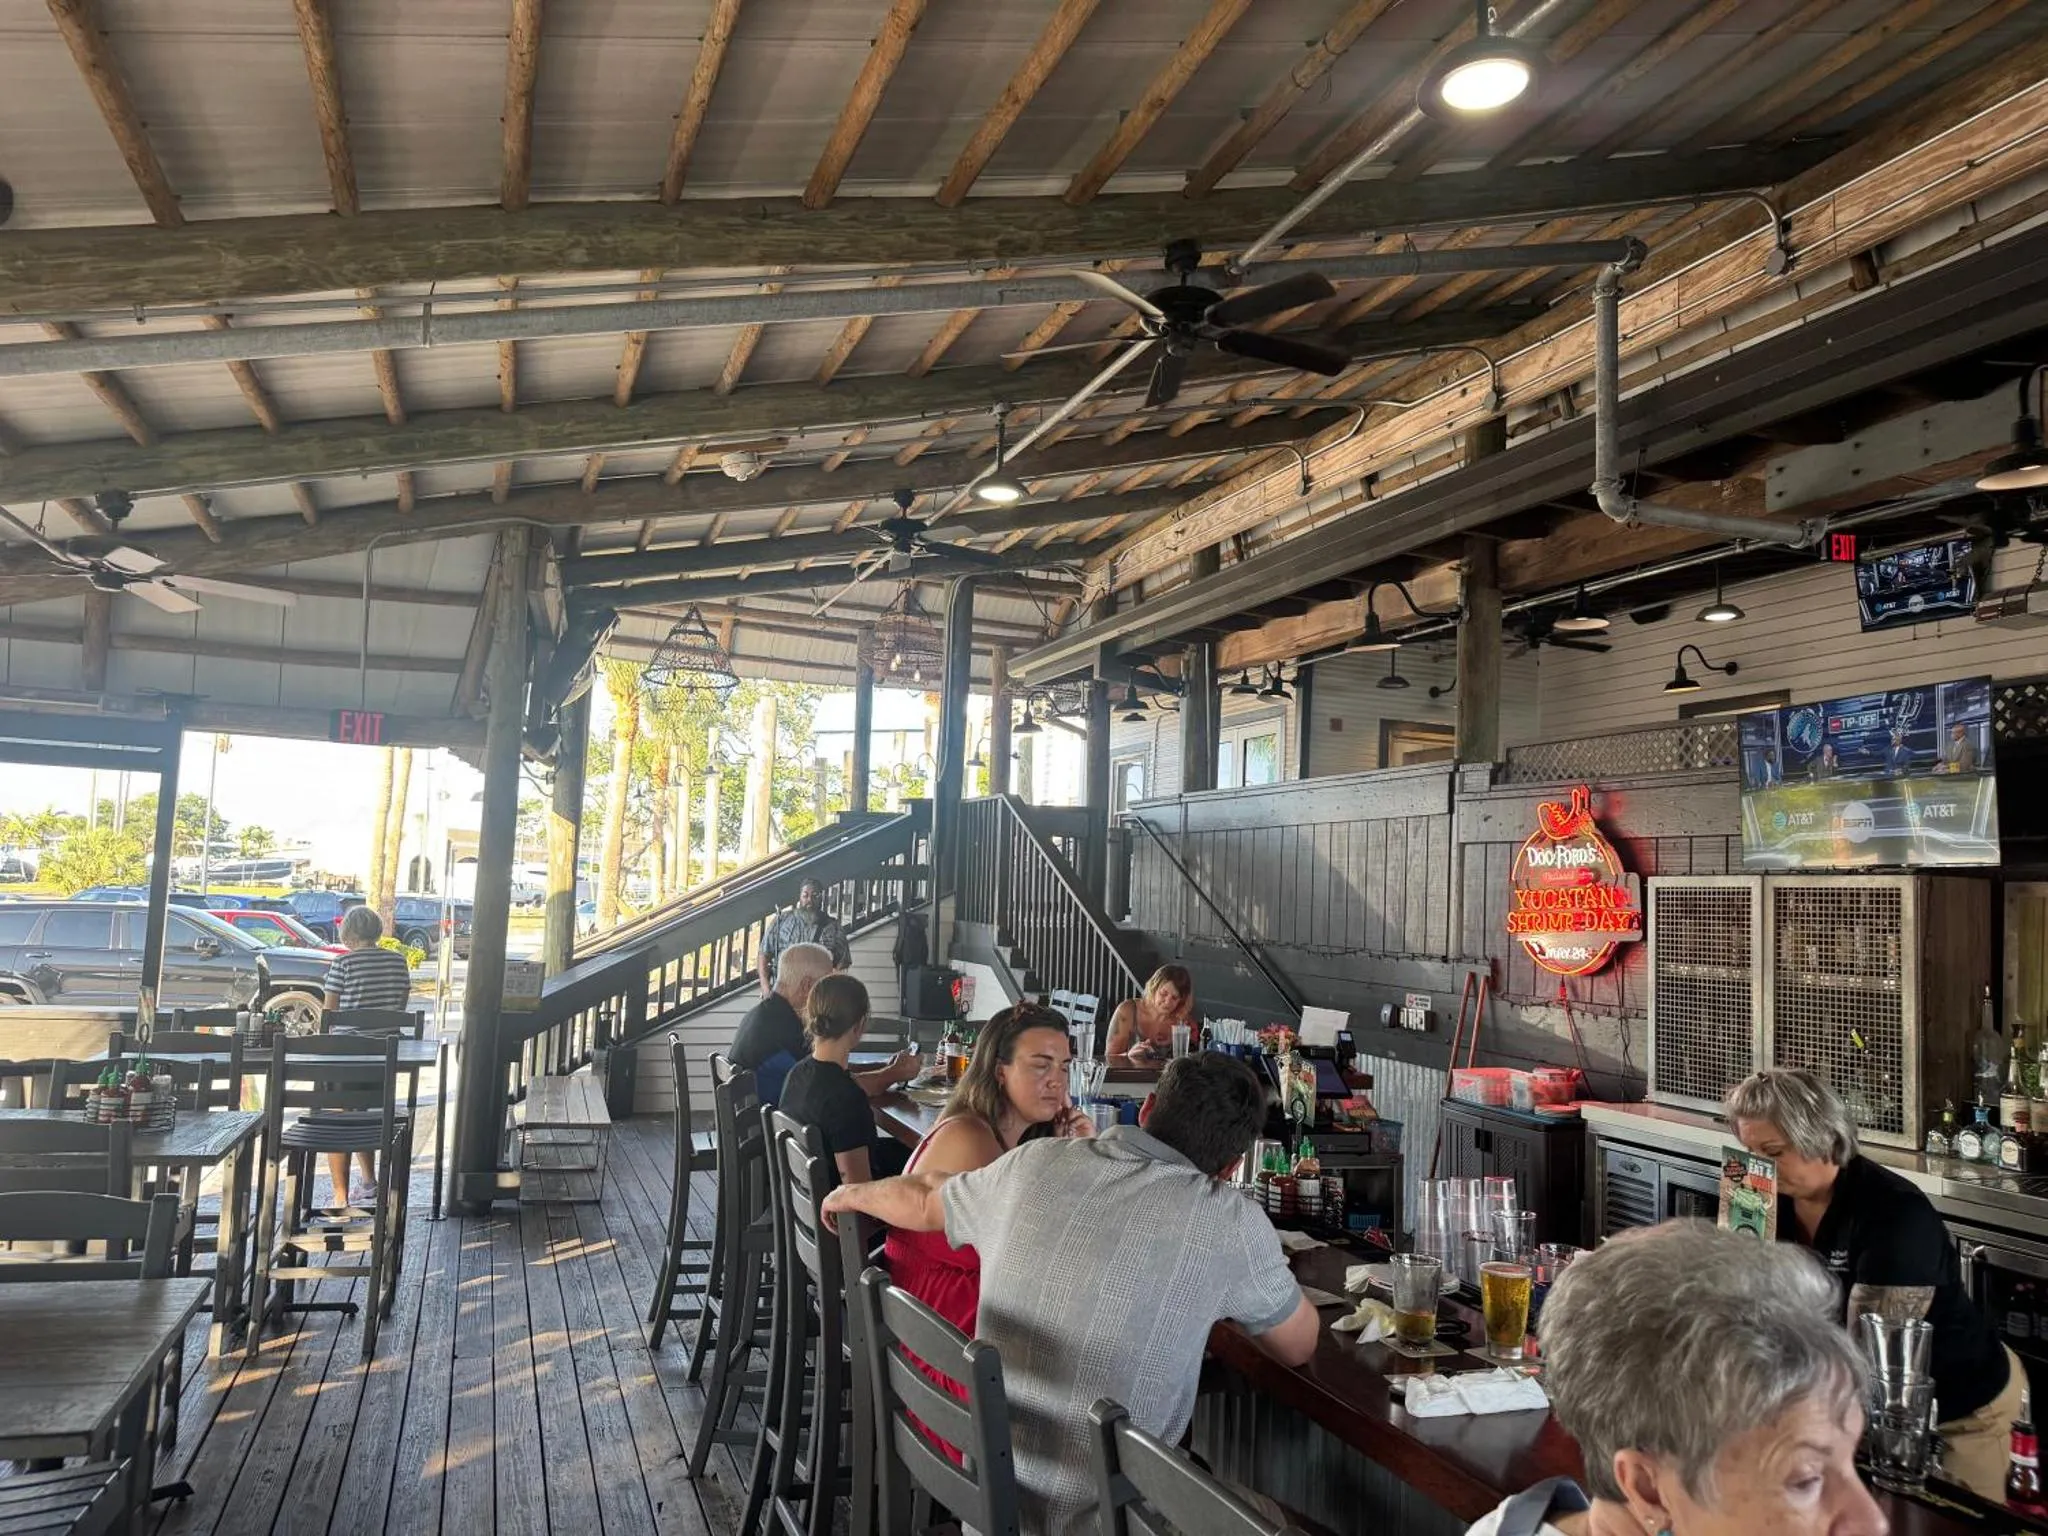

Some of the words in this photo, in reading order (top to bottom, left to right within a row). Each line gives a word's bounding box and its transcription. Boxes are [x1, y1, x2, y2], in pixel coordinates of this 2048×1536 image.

[1832, 534, 1856, 560] EXIT
[340, 710, 385, 743] EXIT
[1840, 714, 1876, 729] TIP-OFF
[1787, 813, 1814, 826] AT&T
[1923, 804, 1957, 818] AT&T
[1515, 883, 1616, 910] YUCATÁN
[1507, 911, 1574, 933] SHRIMP
[1584, 909, 1630, 932] DAY
